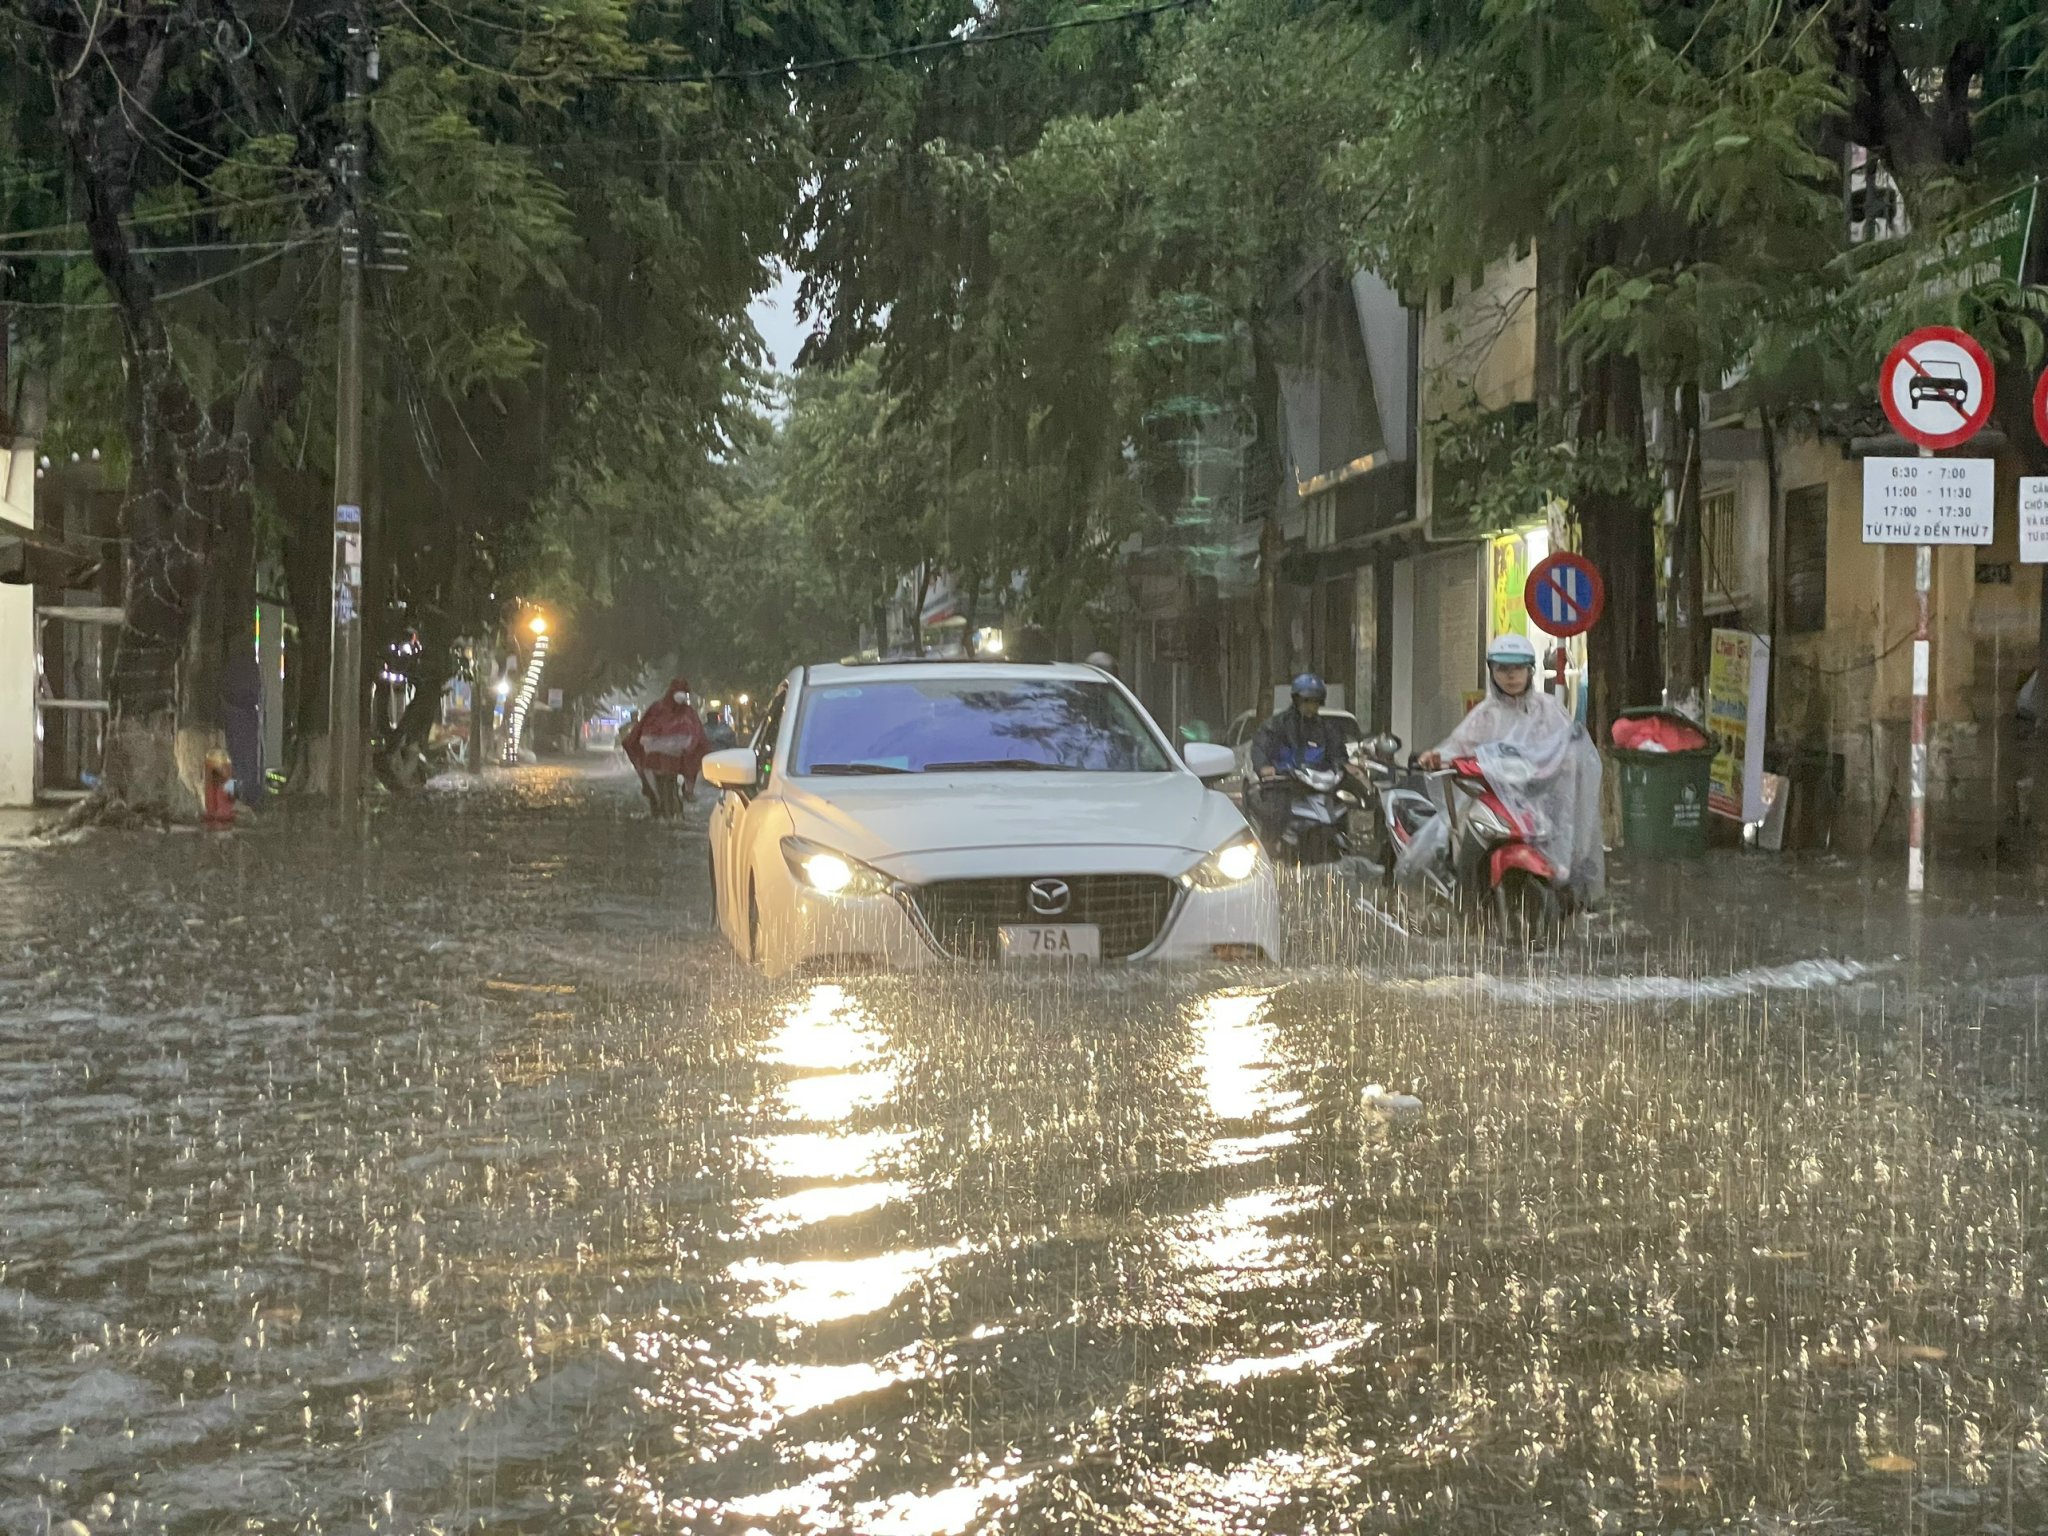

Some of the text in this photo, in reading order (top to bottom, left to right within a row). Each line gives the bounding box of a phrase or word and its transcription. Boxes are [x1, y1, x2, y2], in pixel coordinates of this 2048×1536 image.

[1892, 467, 1918, 478] 6:30
[1940, 467, 1966, 479] 7:00
[1885, 486, 1918, 497] 11:00
[1940, 487, 1972, 498] 11:30
[1884, 506, 1917, 517] 17:00
[1939, 506, 1972, 517] 17:30
[1914, 526, 1921, 536] 2
[1924, 521, 1950, 537] ĐẾN
[1982, 526, 1989, 537] 7
[1028, 929, 1071, 951] 76A
